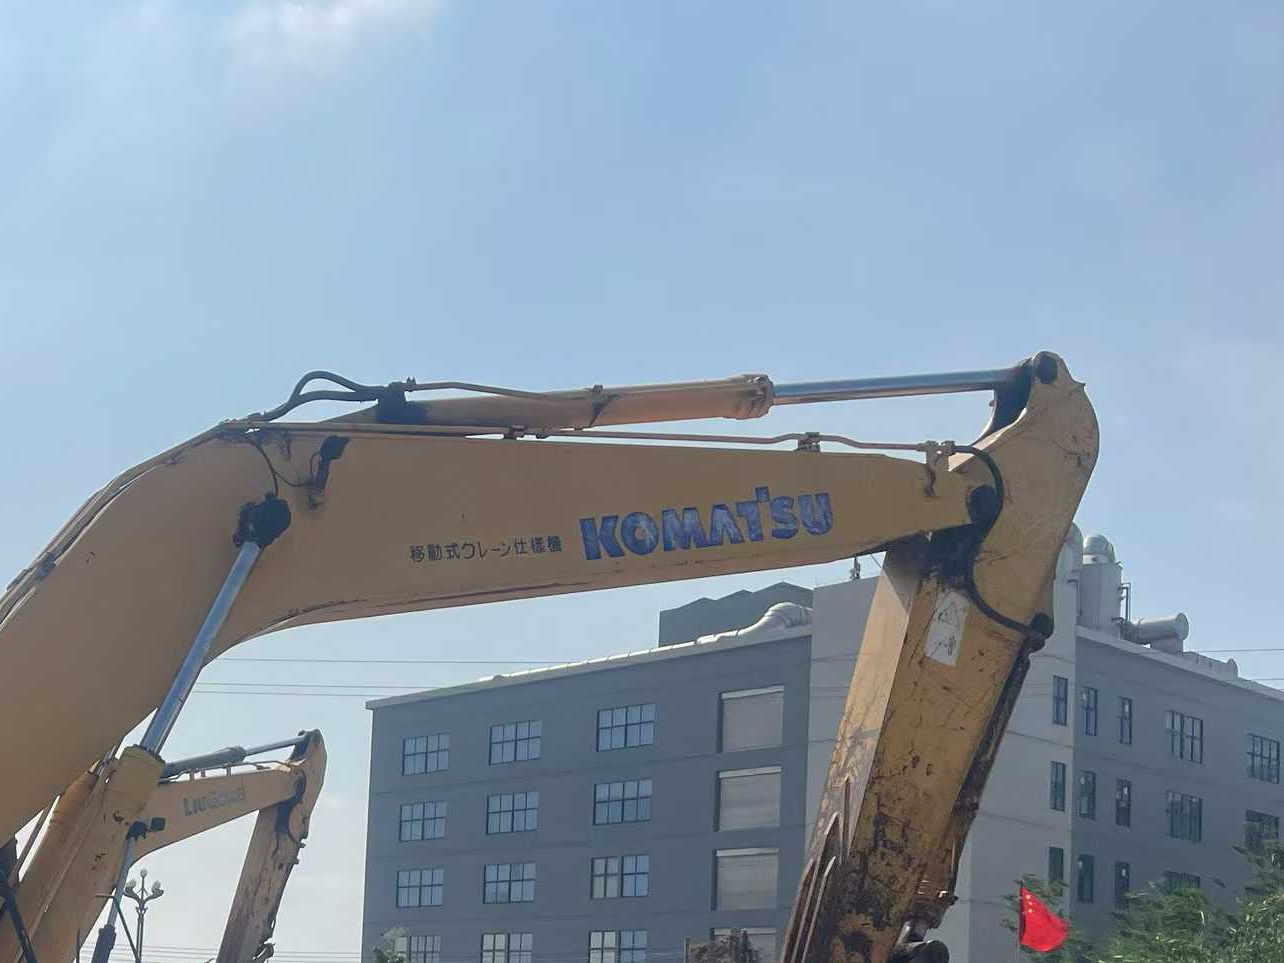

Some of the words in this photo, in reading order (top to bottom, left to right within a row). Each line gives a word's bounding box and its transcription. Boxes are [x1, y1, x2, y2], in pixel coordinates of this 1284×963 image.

[580, 486, 833, 560] KOMATSU
[410, 536, 563, 563] 移動式クレーン仕様機
